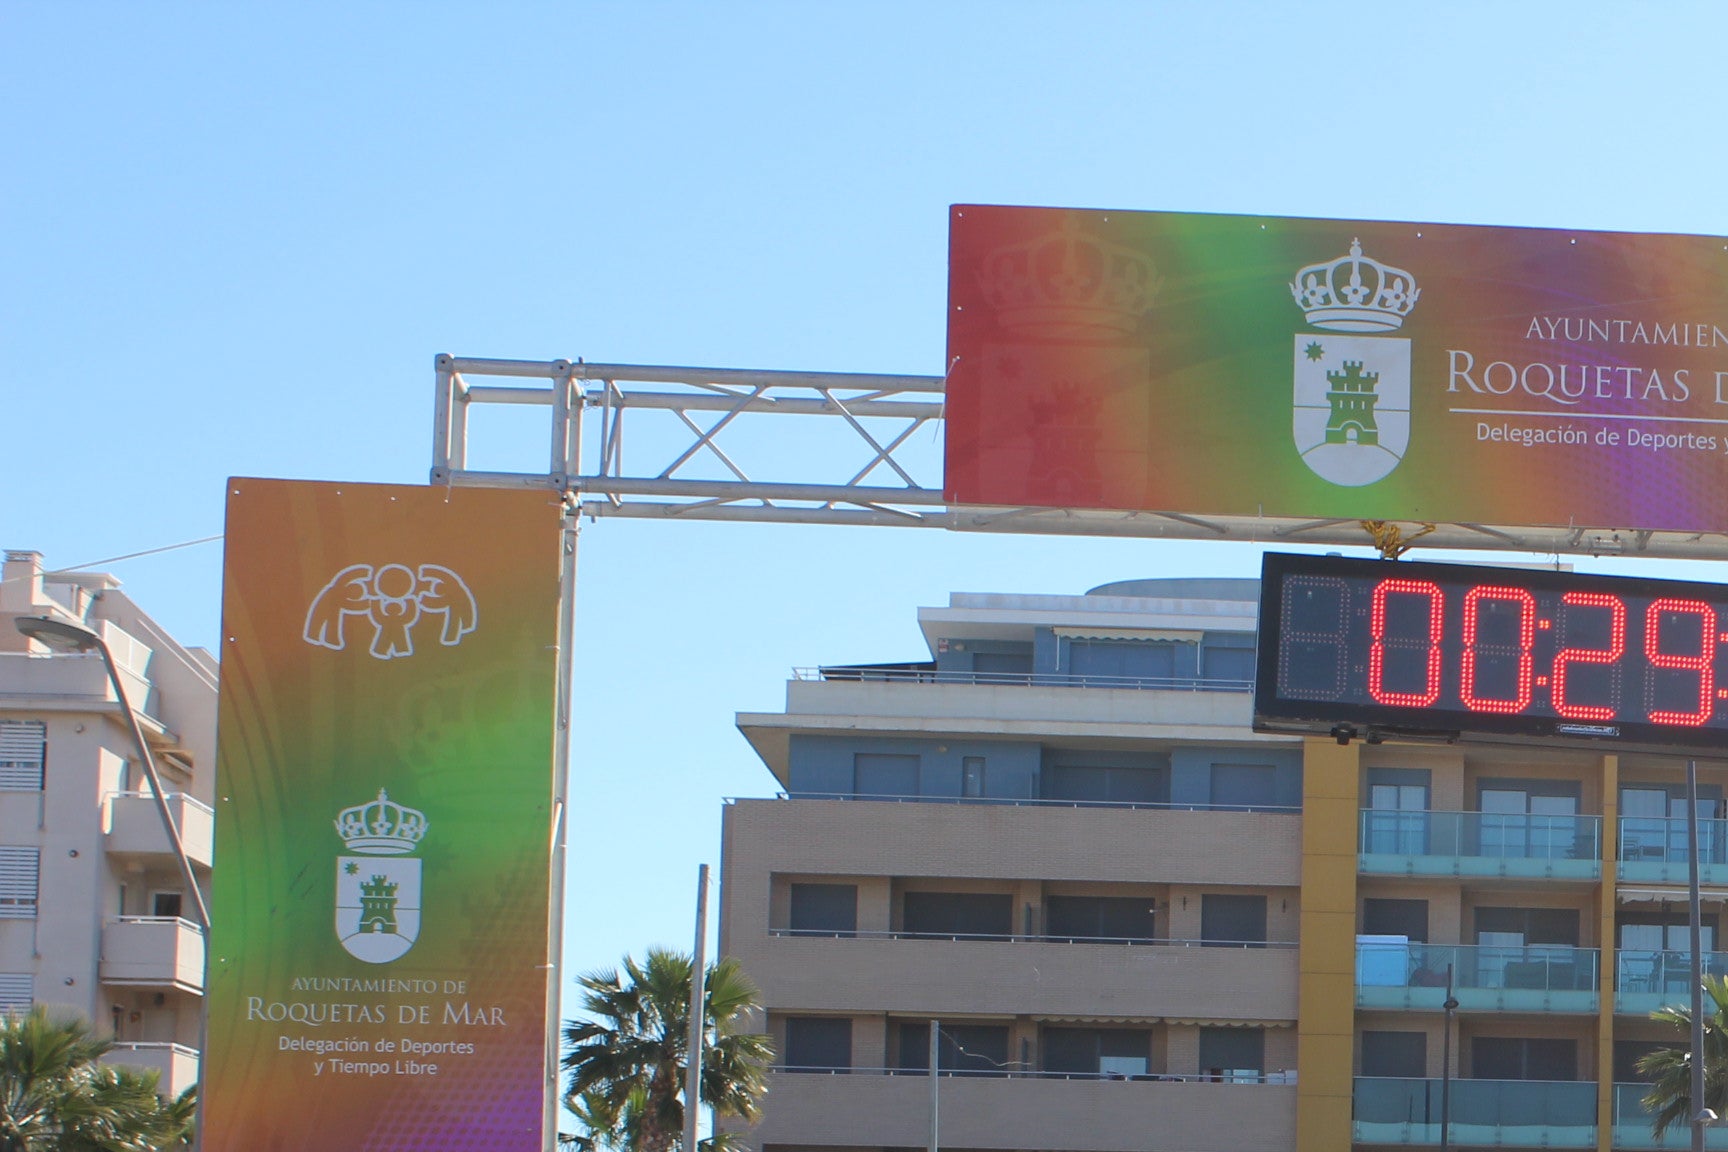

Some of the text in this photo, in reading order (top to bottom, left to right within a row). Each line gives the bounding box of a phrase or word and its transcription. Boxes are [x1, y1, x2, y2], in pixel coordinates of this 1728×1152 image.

[1445, 349, 1691, 405] ROQUETAS
[1476, 422, 1588, 446] Delegación
[1595, 426, 1620, 446] de
[1627, 428, 1717, 452] Deportes
[291, 977, 466, 994] AYUNTAMIENTO DE
[399, 1004, 430, 1025] DE
[278, 1035, 475, 1056] Delegación de Deportes
[314, 1058, 438, 1077] y Tiempo Libre
